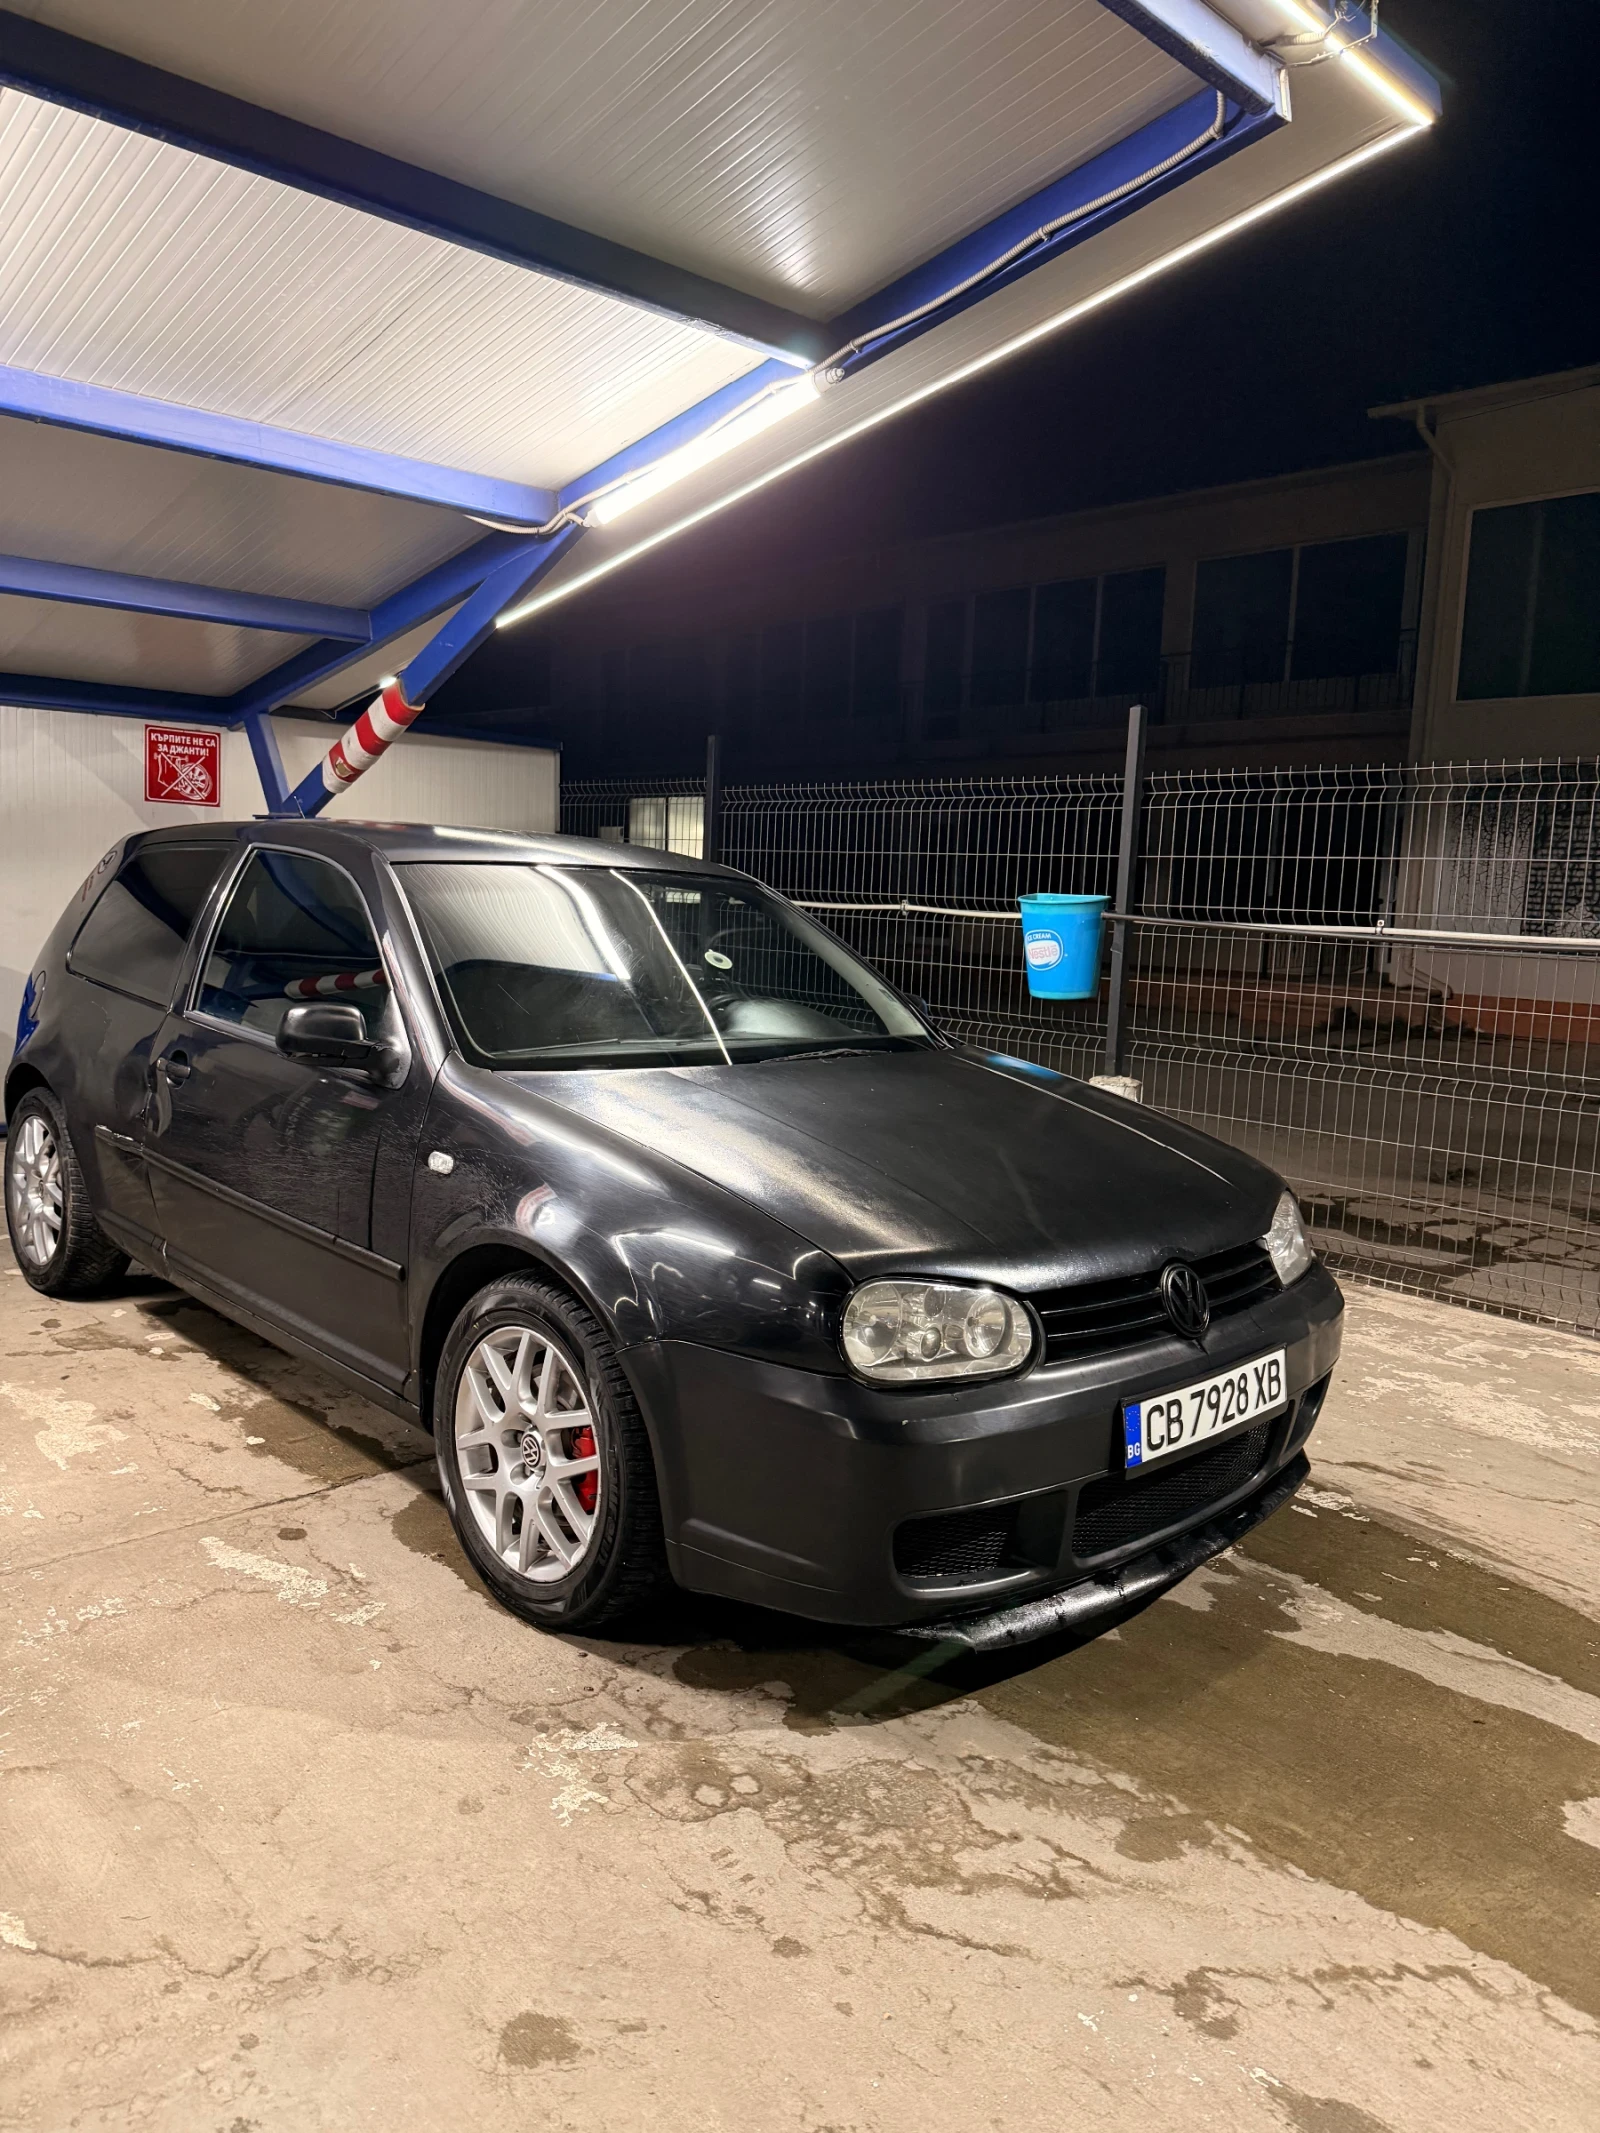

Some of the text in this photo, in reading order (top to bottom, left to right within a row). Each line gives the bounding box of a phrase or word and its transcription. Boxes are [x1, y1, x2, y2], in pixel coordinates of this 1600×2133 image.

[151, 733, 216, 748] КЪРПИТЕ НЕ СА
[157, 744, 209, 756] ЗА ДЖАНТИ!
[1146, 1358, 1282, 1452] CB 7928 XB
[1127, 1442, 1141, 1459] BG
